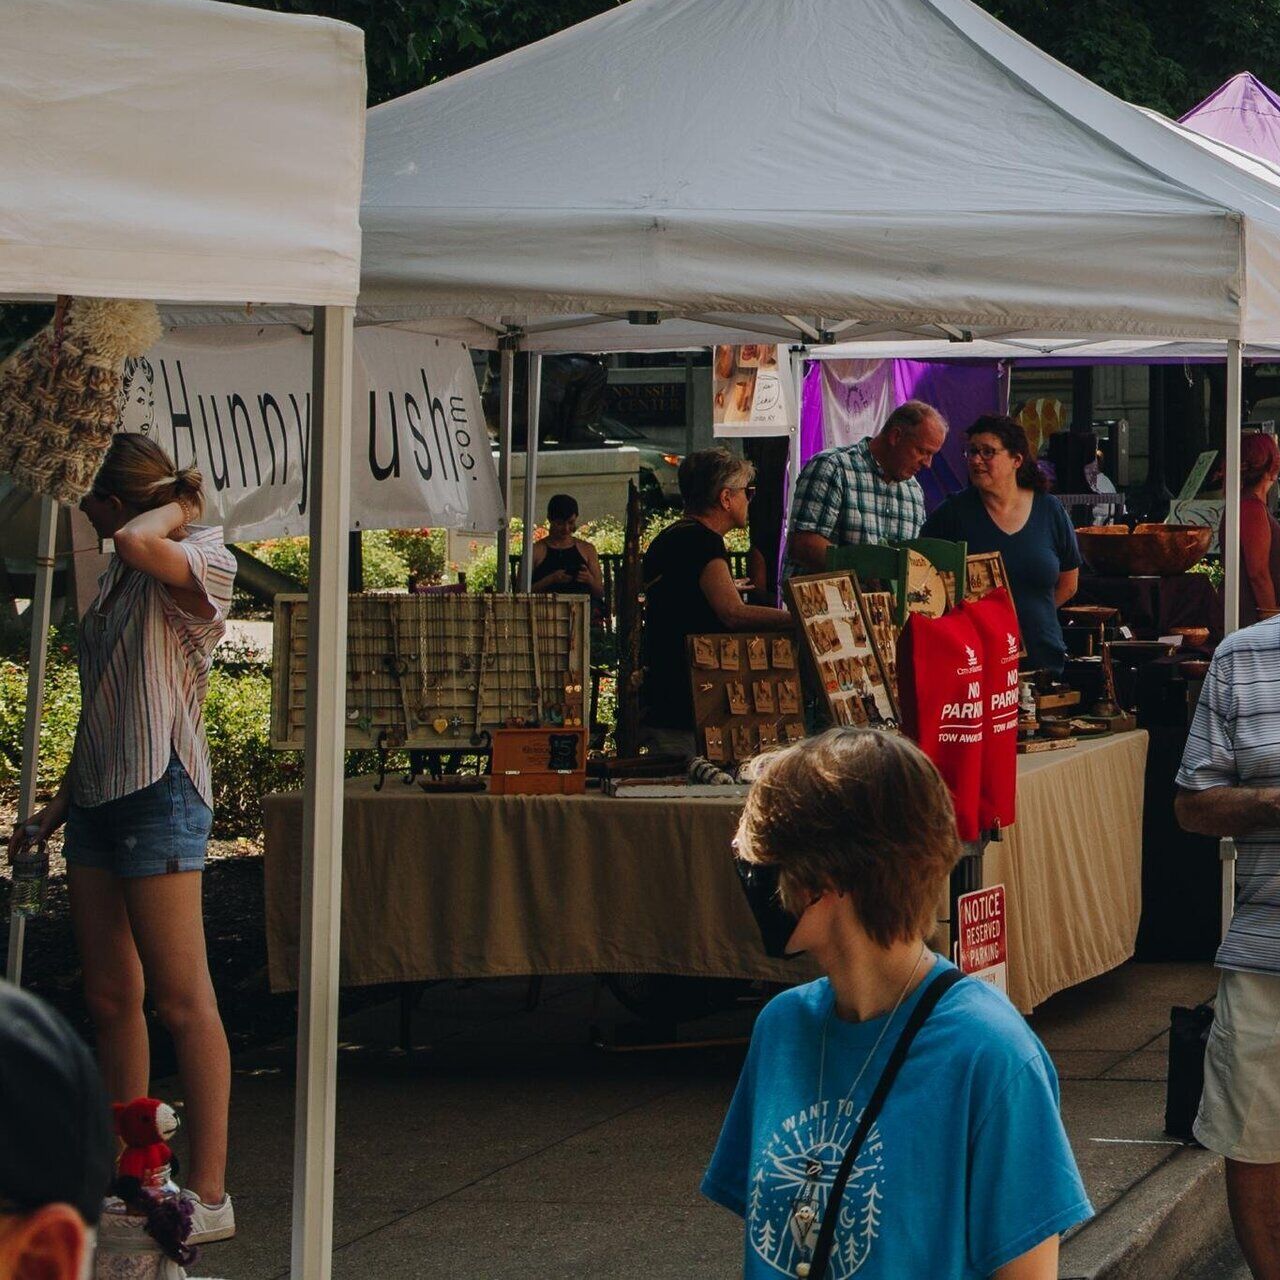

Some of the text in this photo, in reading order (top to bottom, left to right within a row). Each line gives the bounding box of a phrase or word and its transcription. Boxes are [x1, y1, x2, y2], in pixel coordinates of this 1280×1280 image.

[450, 396, 478, 481] .com
[968, 681, 980, 699] NO
[1007, 669, 1018, 686] NO
[939, 733, 958, 742] TOW
[993, 723, 1006, 734] TOW
[964, 892, 1000, 924] NOTICE
[966, 920, 1000, 946] RESERVED
[970, 942, 999, 968] PARKING
[782, 1100, 829, 1133] WANT
[837, 1099, 854, 1118] TO
[855, 1107, 884, 1155] LVE
